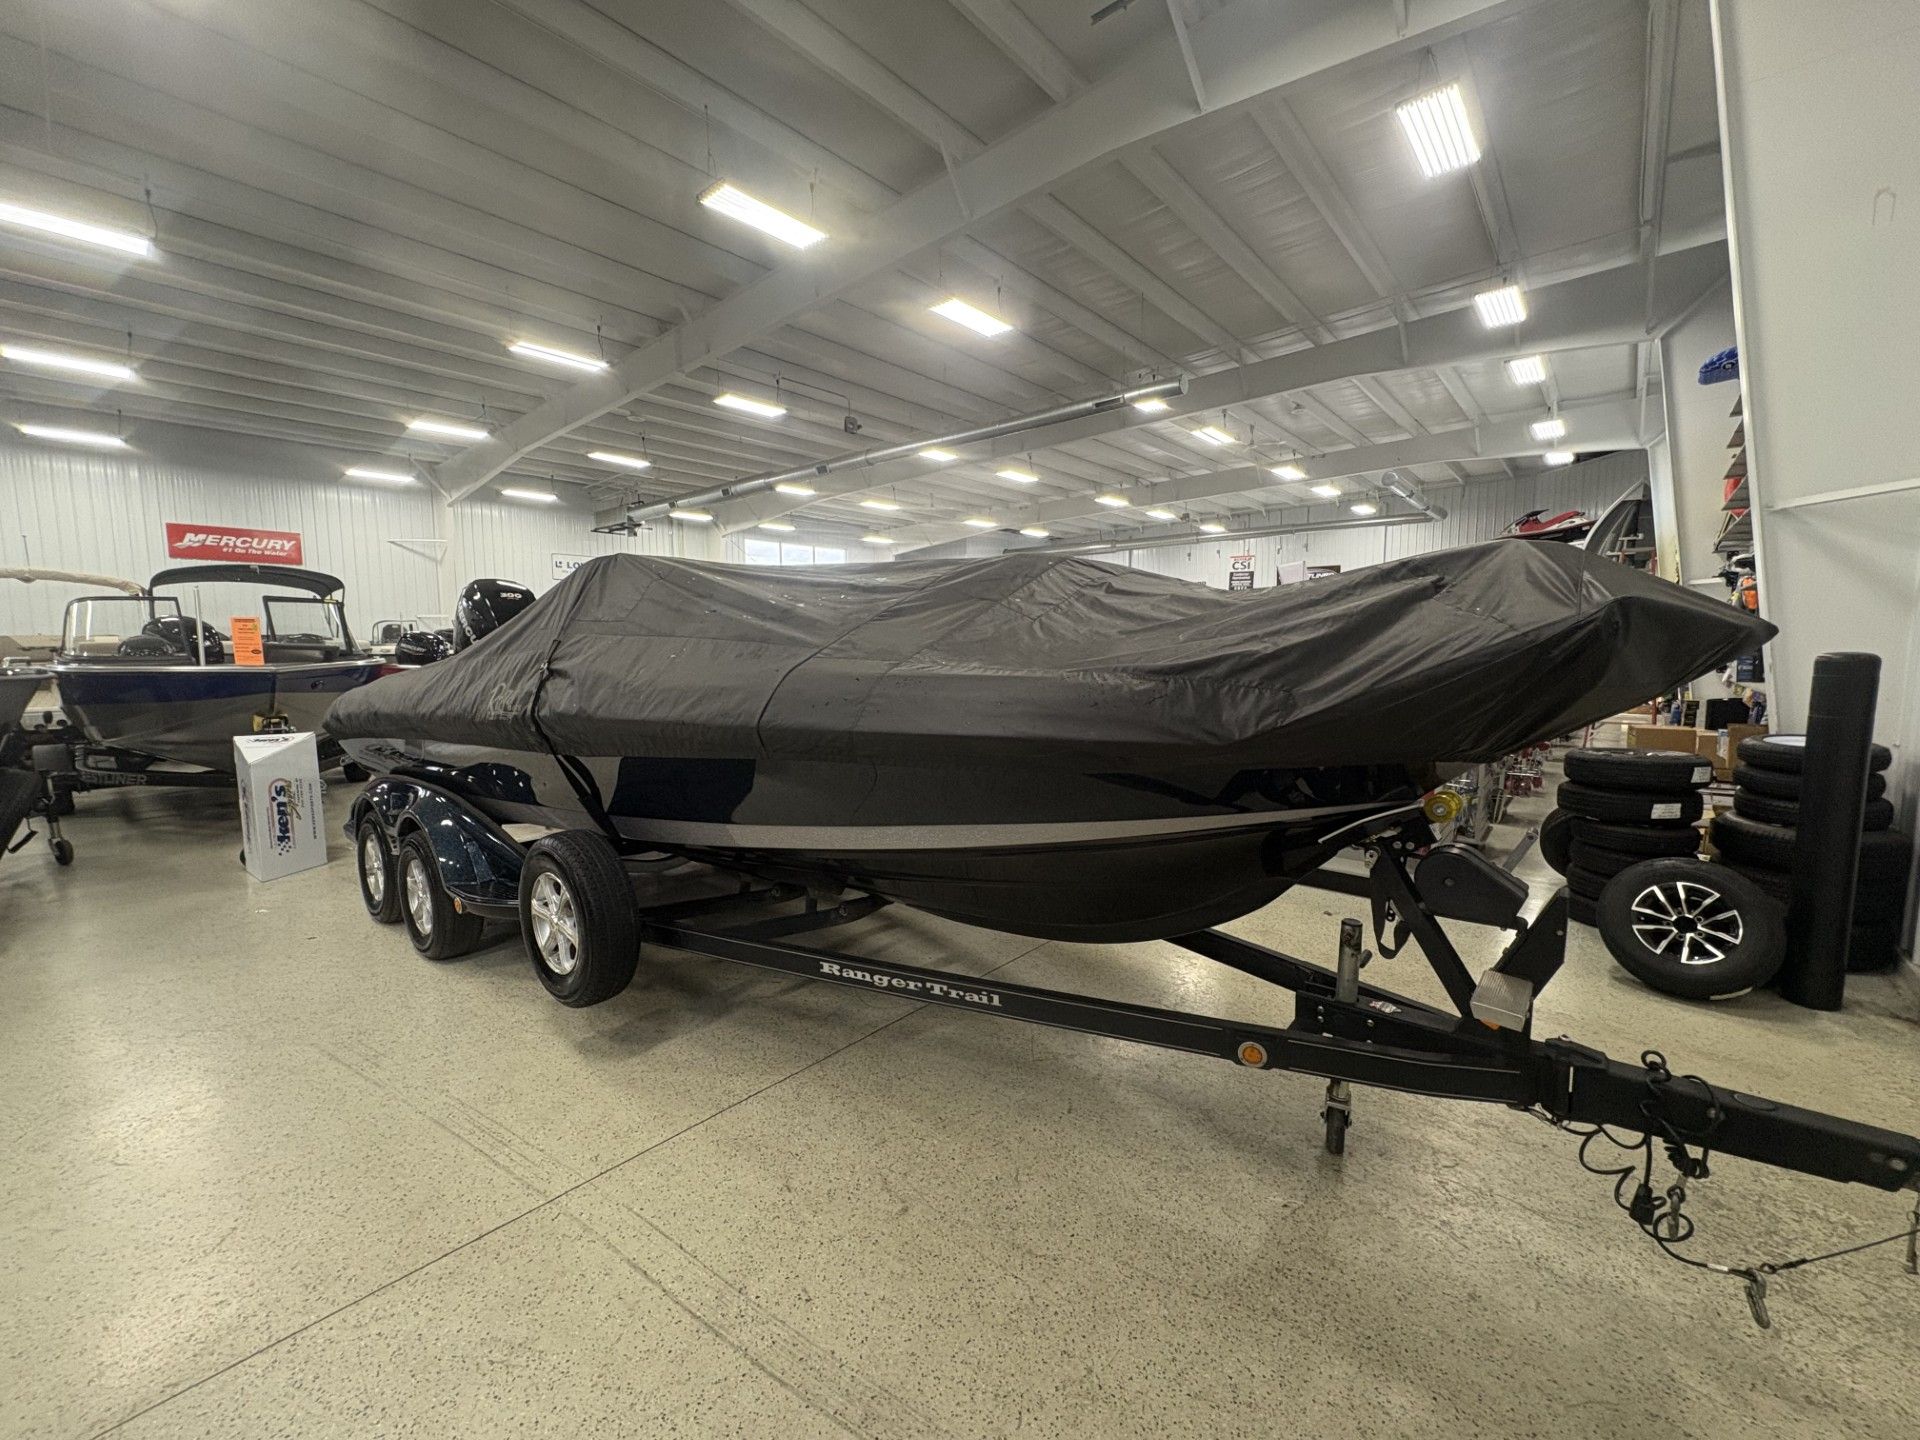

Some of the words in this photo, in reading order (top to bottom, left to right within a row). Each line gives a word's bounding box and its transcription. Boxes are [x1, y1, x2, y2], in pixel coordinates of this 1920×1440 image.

[174, 533, 296, 550] MERCURY
[1232, 561, 1251, 570] CSI
[271, 784, 291, 843] ken's
[819, 961, 922, 991] Ranger
[926, 981, 1002, 1007] Trail
